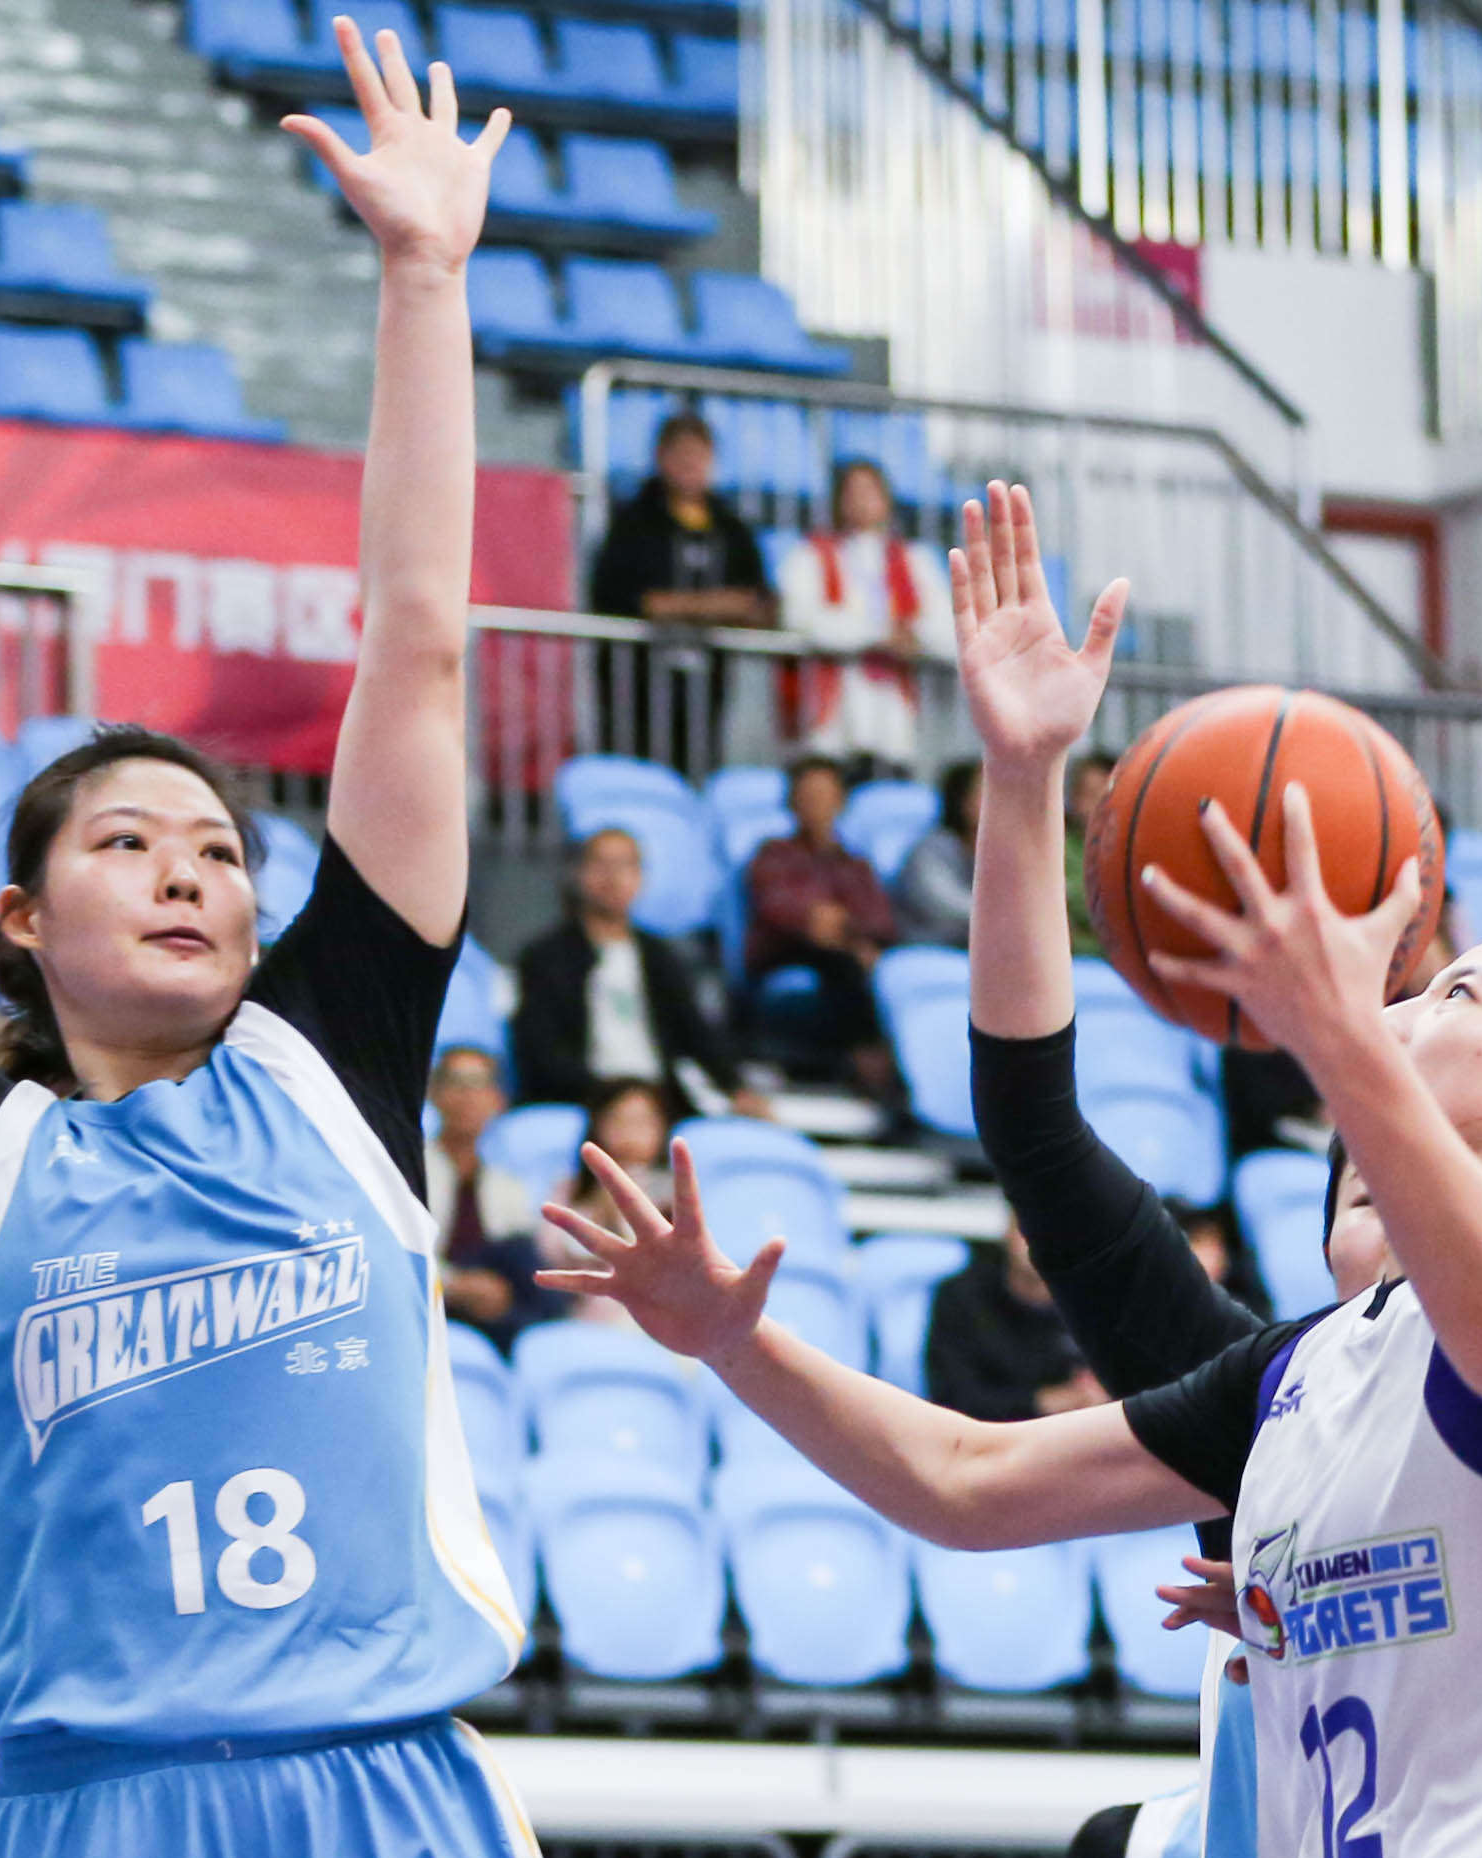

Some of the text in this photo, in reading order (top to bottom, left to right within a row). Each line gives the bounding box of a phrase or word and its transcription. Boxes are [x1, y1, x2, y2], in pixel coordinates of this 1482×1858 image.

[31, 1251, 120, 1300] THE
[285, 1337, 372, 1375] 北京
[142, 1467, 317, 1616] 18
